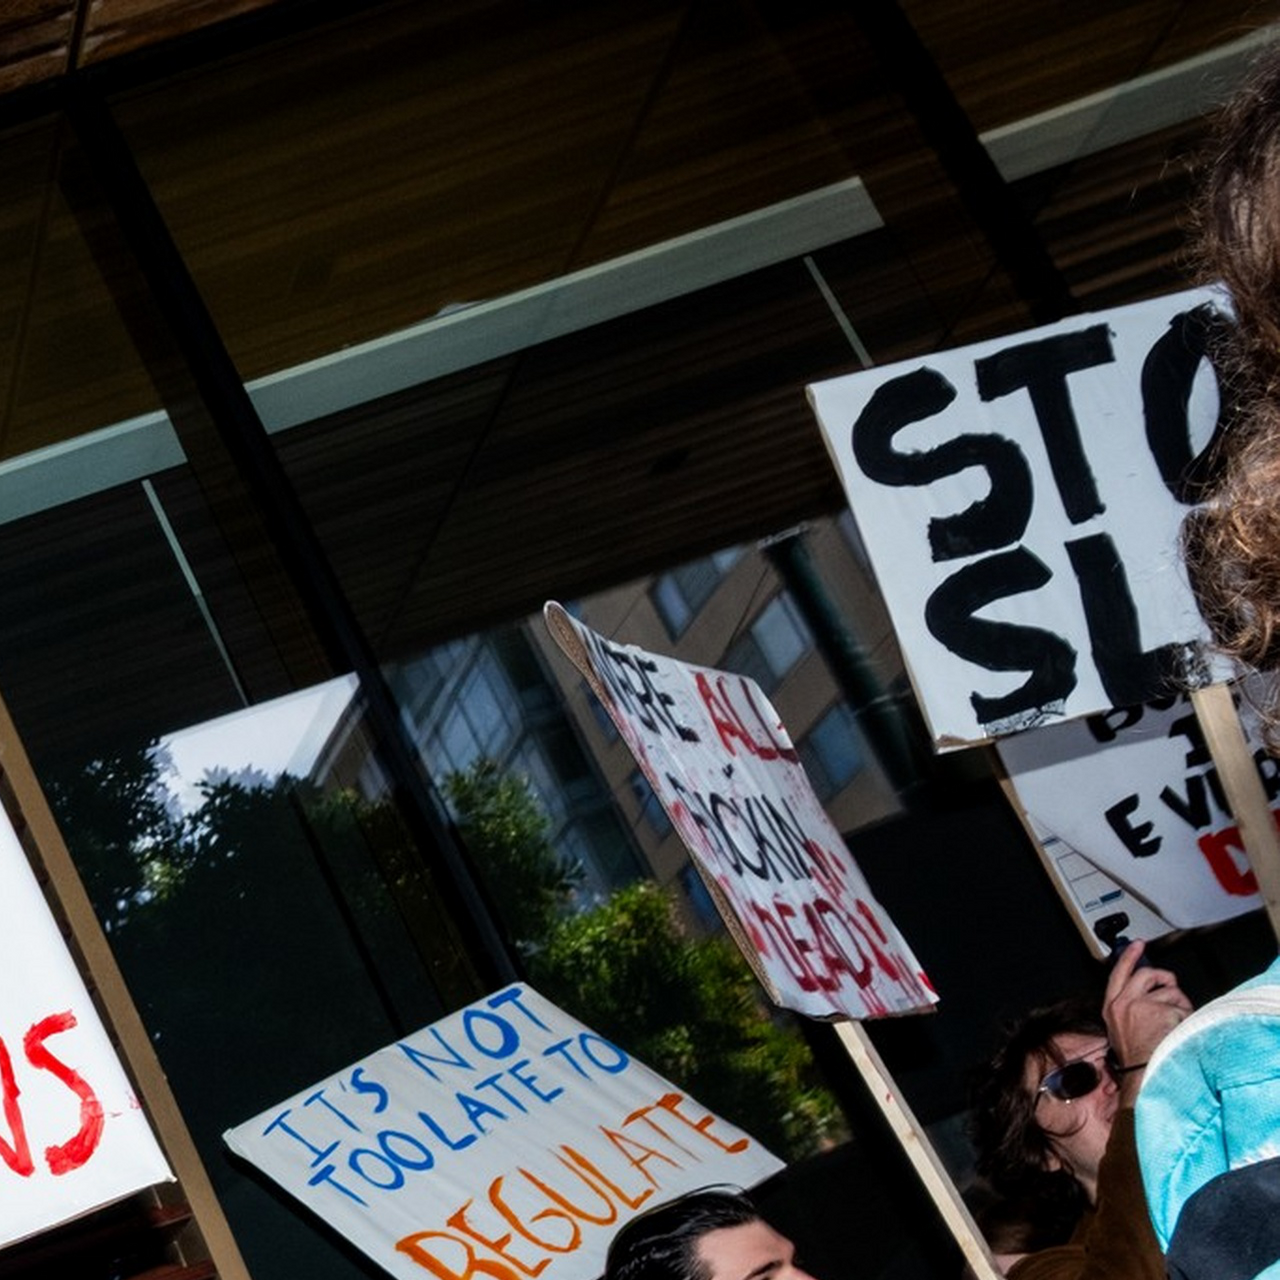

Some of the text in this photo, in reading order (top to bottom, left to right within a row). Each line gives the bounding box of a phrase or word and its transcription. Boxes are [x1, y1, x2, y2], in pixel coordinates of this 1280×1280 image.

[263, 987, 554, 1168] IT'S NOT
[543, 1031, 632, 1081] TO
